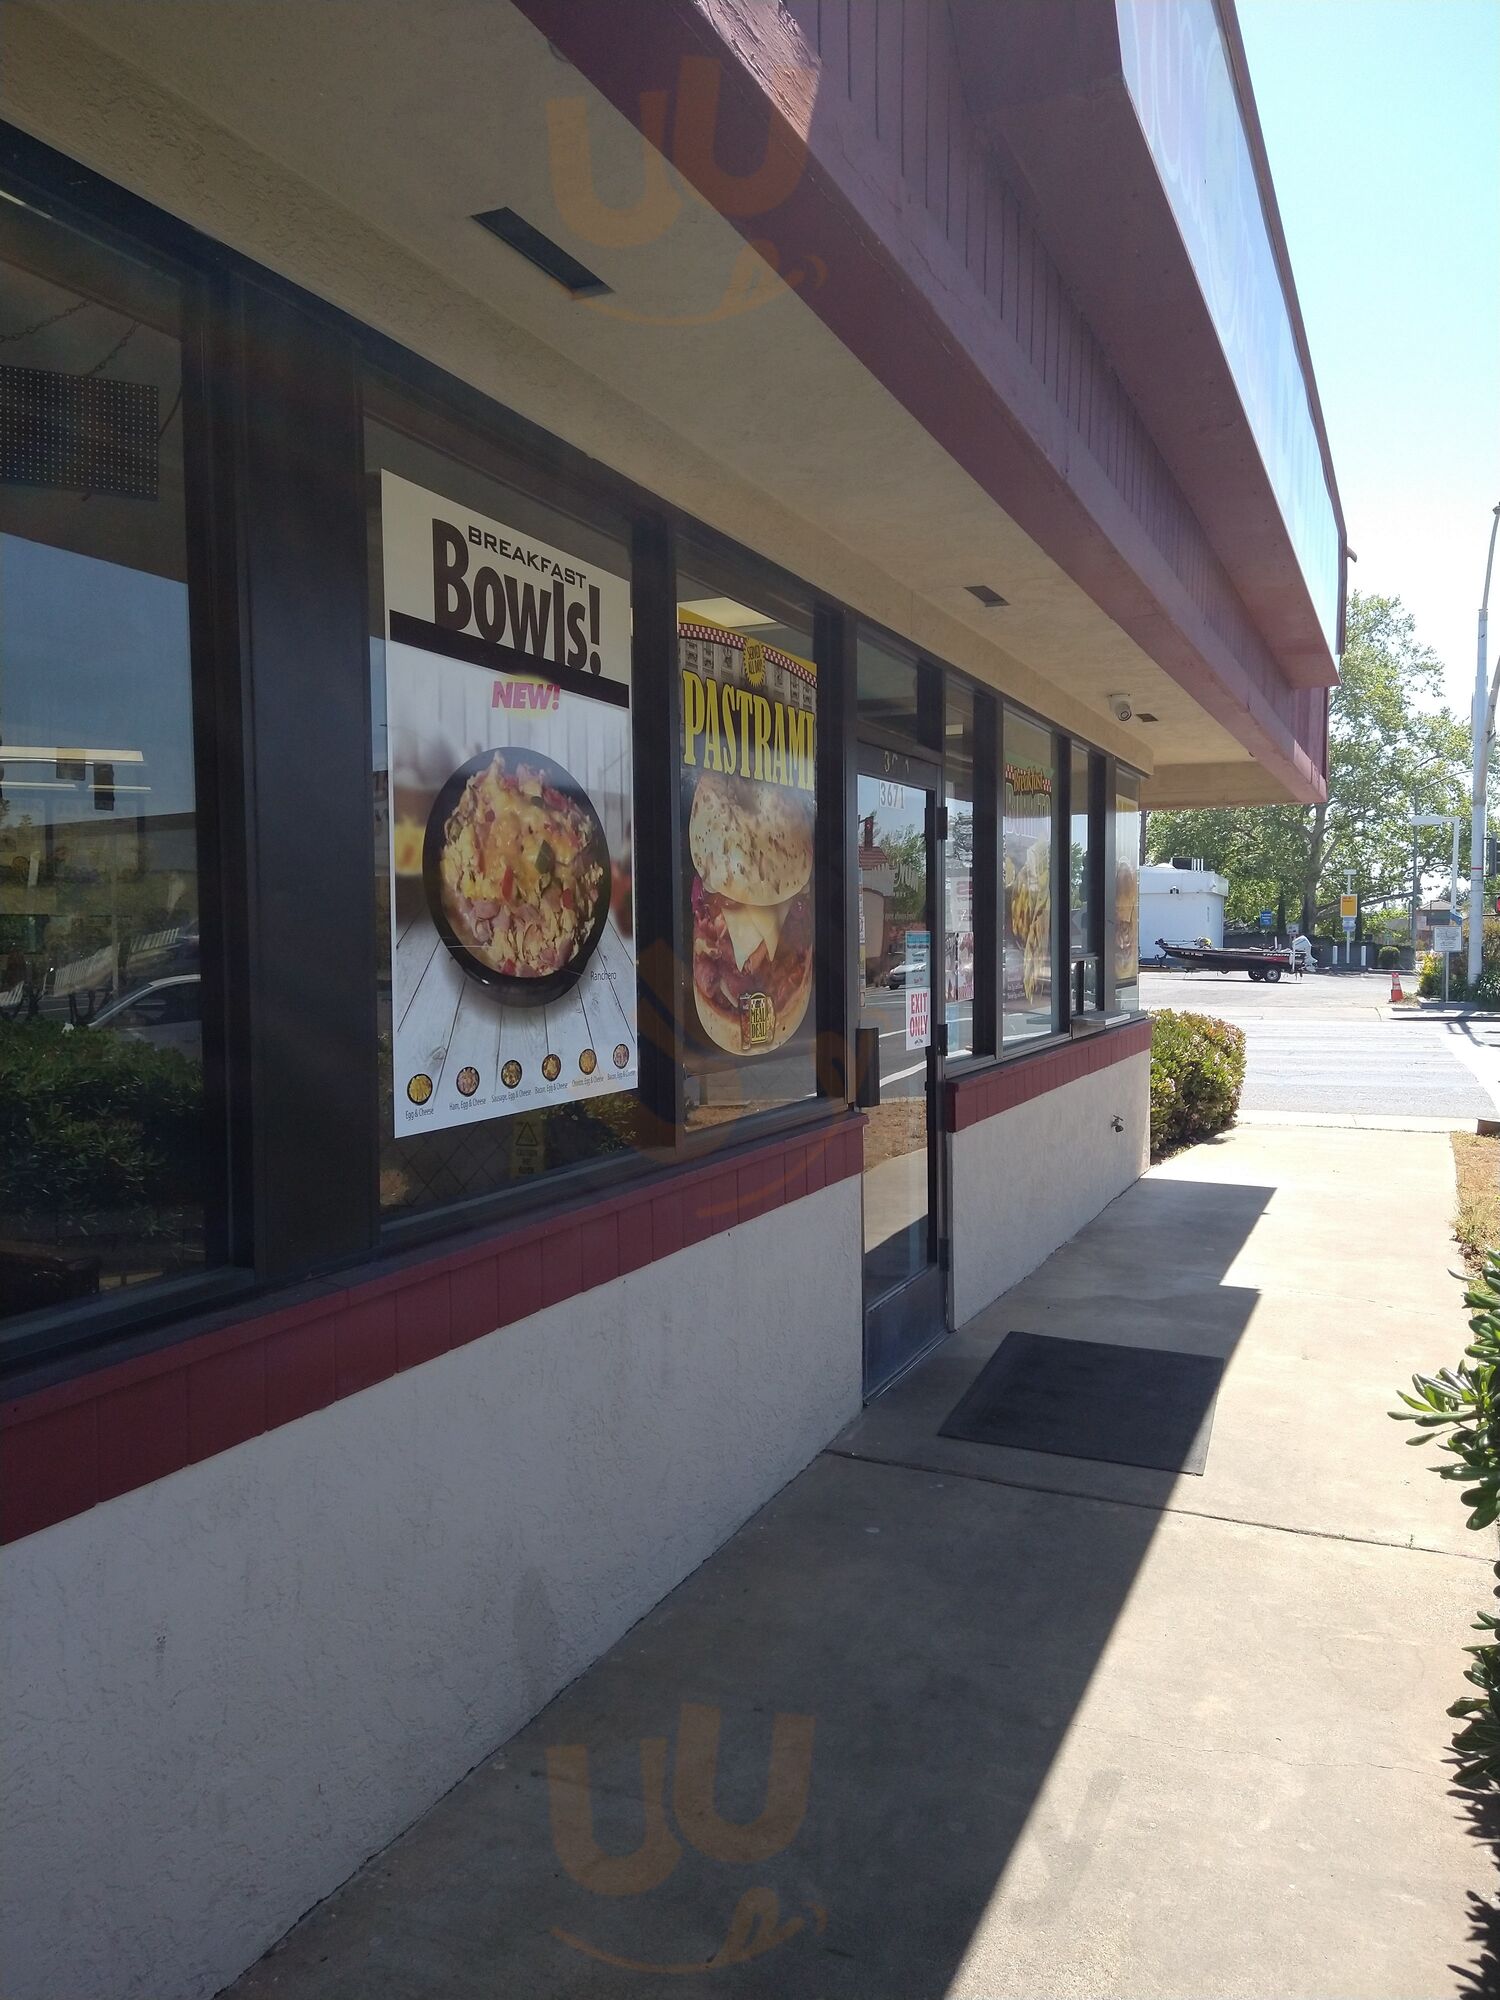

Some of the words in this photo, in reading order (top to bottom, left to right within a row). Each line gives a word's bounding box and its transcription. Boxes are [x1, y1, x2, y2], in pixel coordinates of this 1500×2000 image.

[467, 524, 587, 589] BREAKFAST
[431, 517, 602, 677] Bowls!
[491, 680, 561, 711] NEW!
[682, 668, 816, 792] PASTRAMI
[880, 781, 905, 810] 3671
[590, 969, 617, 982] Ranchero
[910, 992, 928, 1015] EXIT
[750, 1007, 767, 1024] MEAL
[909, 1014, 929, 1038] ONLY
[751, 1022, 767, 1039] DEAL
[405, 1110, 415, 1121] Egg
[418, 1107, 434, 1117] Cheese
[460, 1100, 469, 1110] Egg
